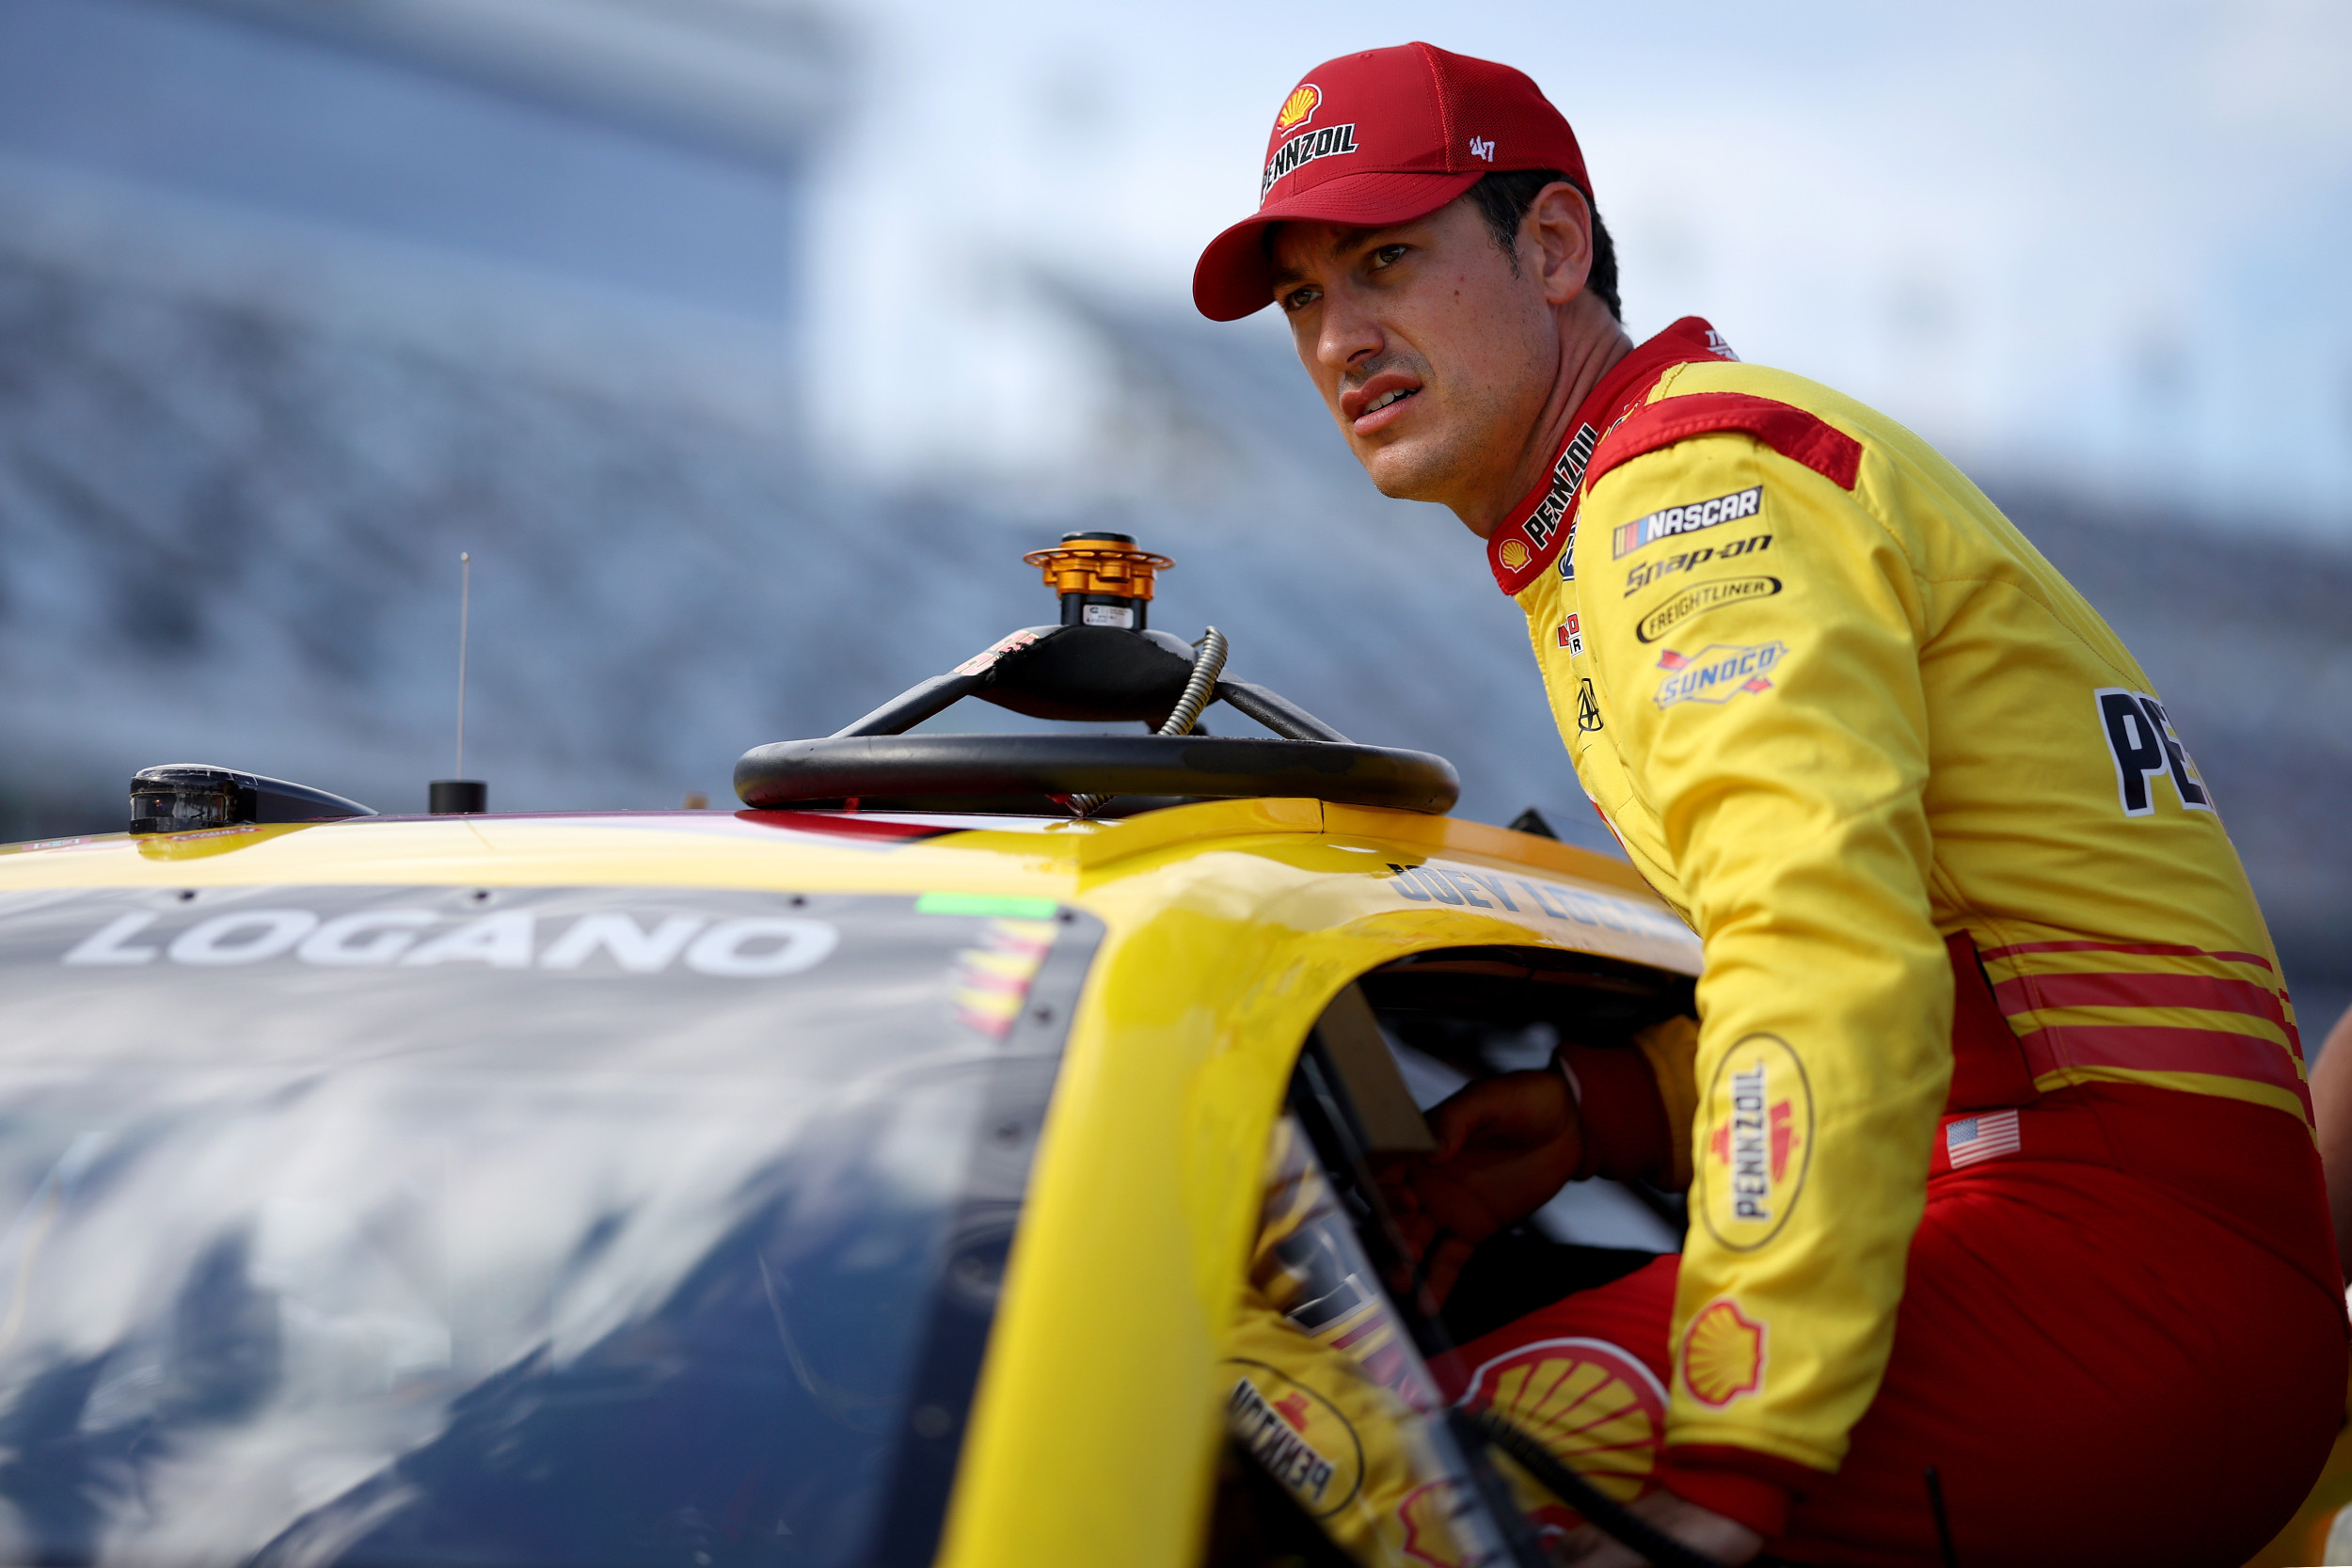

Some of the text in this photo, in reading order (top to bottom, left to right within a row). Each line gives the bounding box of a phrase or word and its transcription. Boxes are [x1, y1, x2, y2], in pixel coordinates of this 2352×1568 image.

[1646, 488, 1759, 540] NASCAR
[1649, 579, 1765, 637] FREIGHTLINER
[1661, 646, 1777, 701] SUNOCO
[1387, 863, 1519, 912] JOEY
[61, 908, 839, 977] LOGANO
[1730, 1061, 1770, 1219] PENNZOIL
